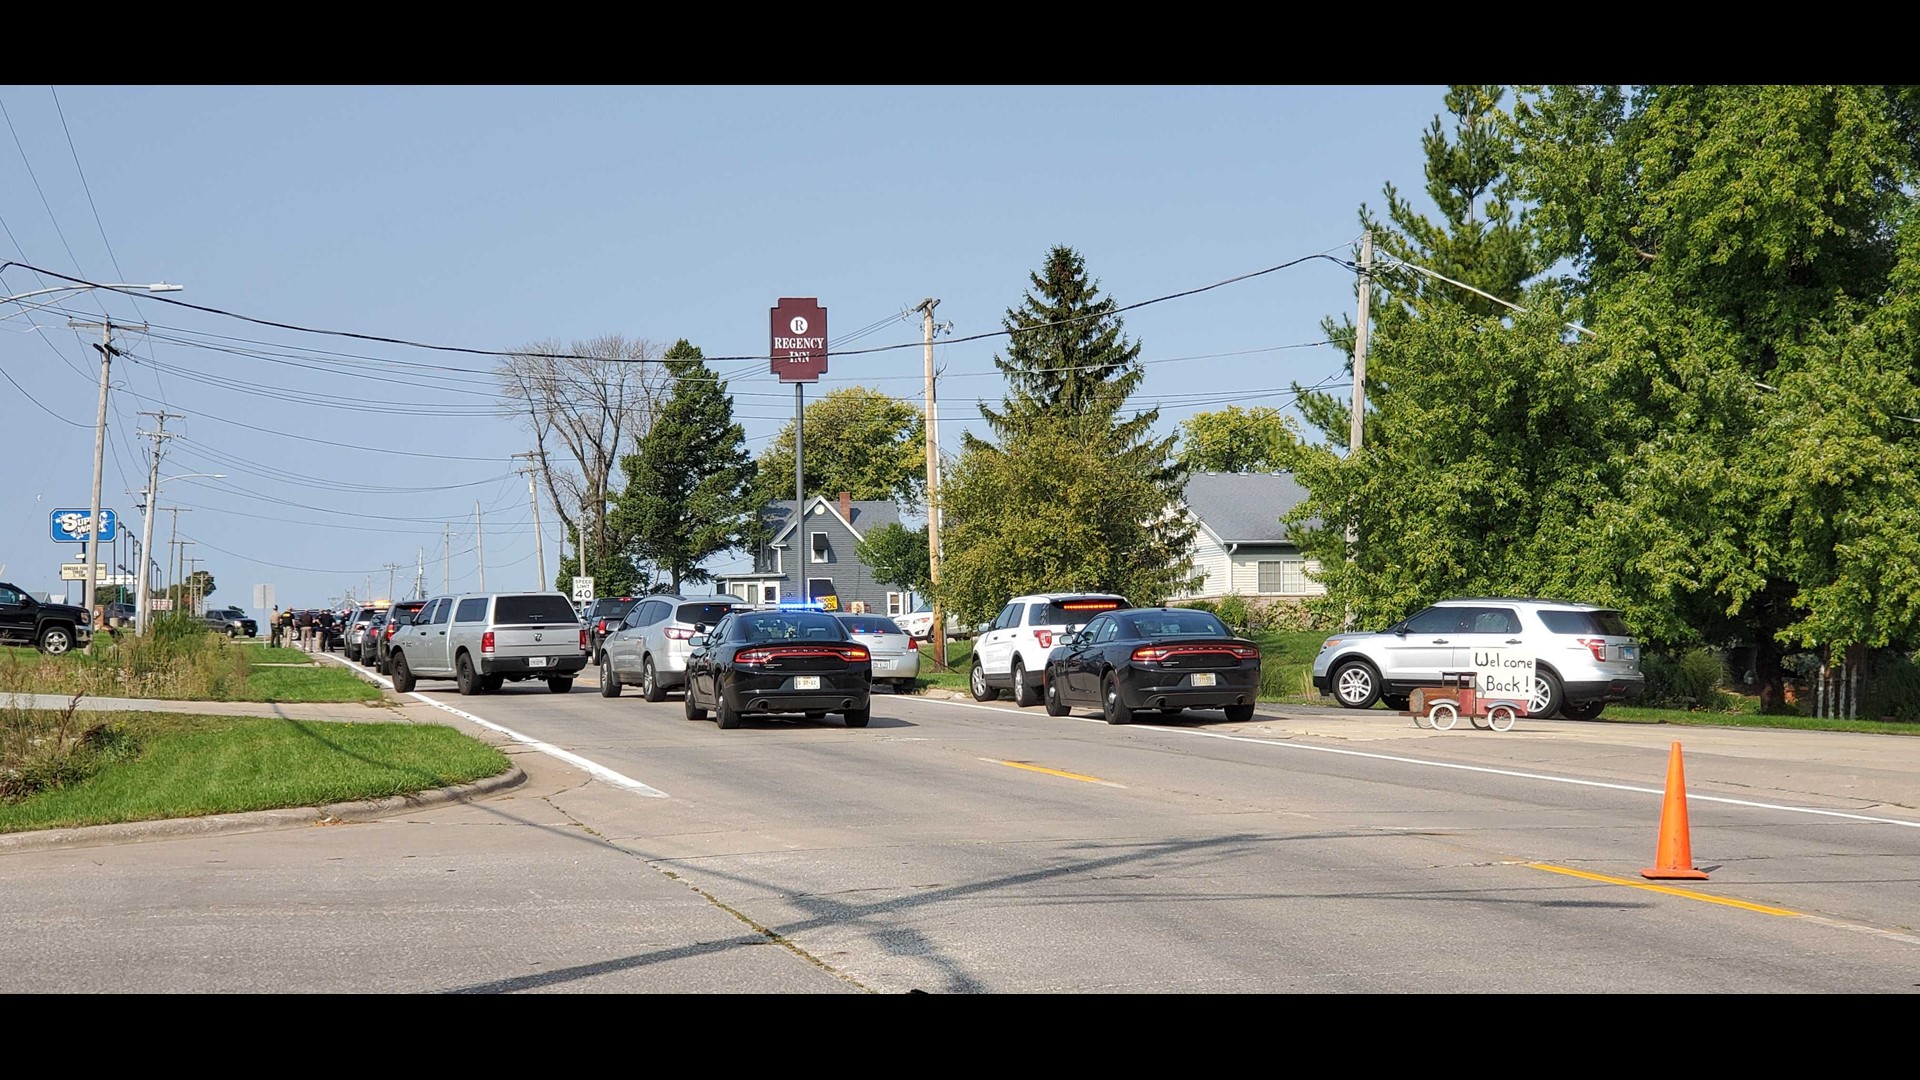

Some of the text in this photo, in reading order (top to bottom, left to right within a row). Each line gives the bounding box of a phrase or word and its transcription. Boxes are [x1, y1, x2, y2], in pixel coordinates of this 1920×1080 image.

[795, 320, 804, 331] R
[774, 337, 825, 349] REGENCY
[789, 351, 810, 363] INN
[575, 589, 592, 599] 40
[1474, 652, 1533, 669] Welcome
